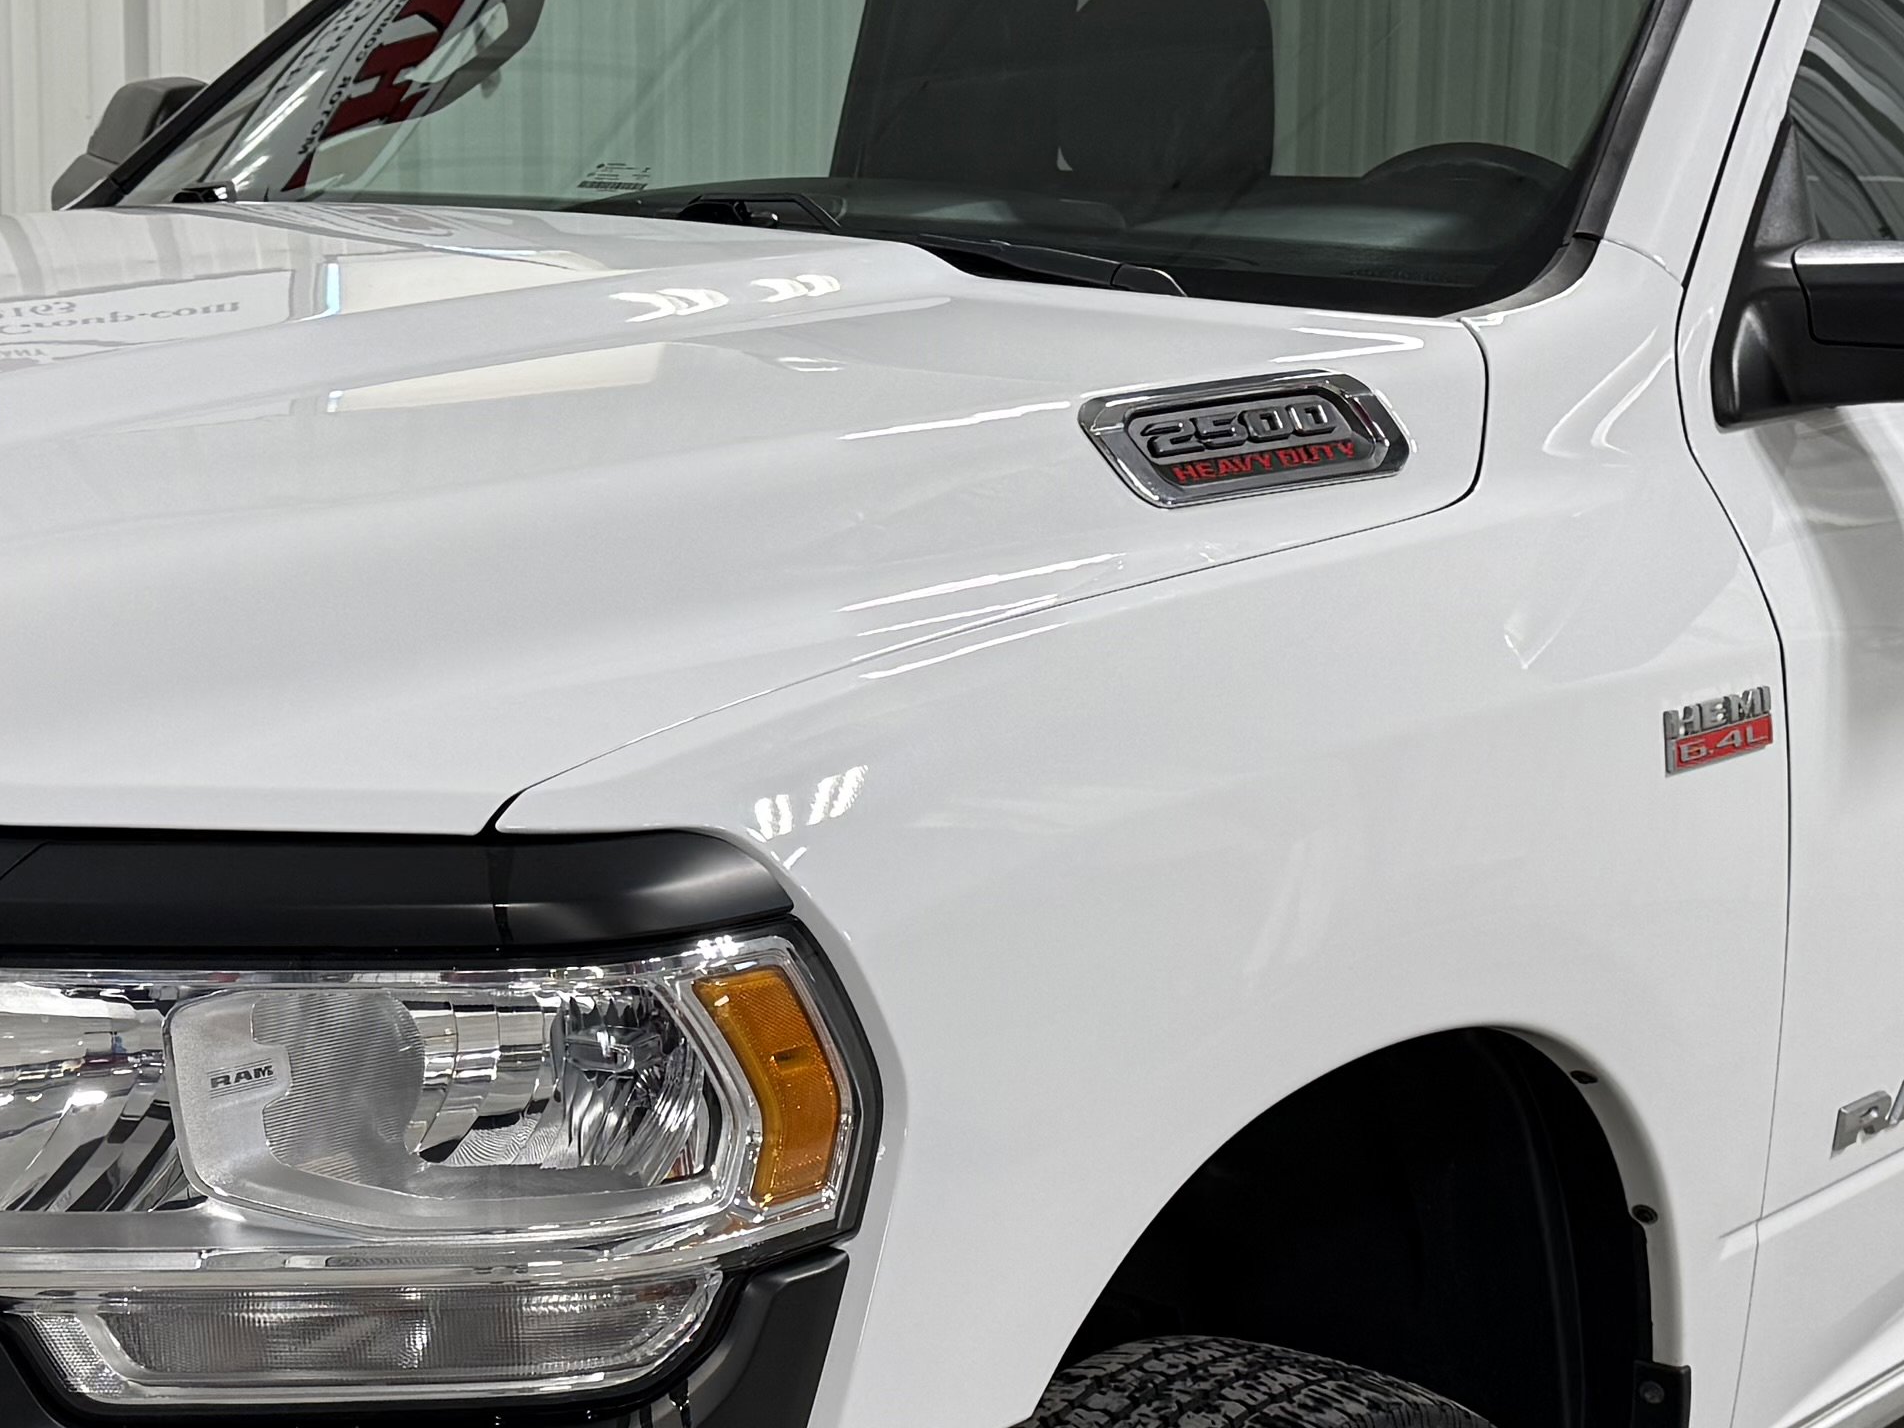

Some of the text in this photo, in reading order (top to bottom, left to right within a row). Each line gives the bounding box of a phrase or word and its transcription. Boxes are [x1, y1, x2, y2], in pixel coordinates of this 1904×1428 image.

[1139, 403, 1336, 459] 2500
[1174, 441, 1357, 484] HEAVY DUTY
[1663, 685, 1772, 739] HEMI
[1679, 719, 1768, 763] 6.4L
[210, 1064, 274, 1089] RAM
